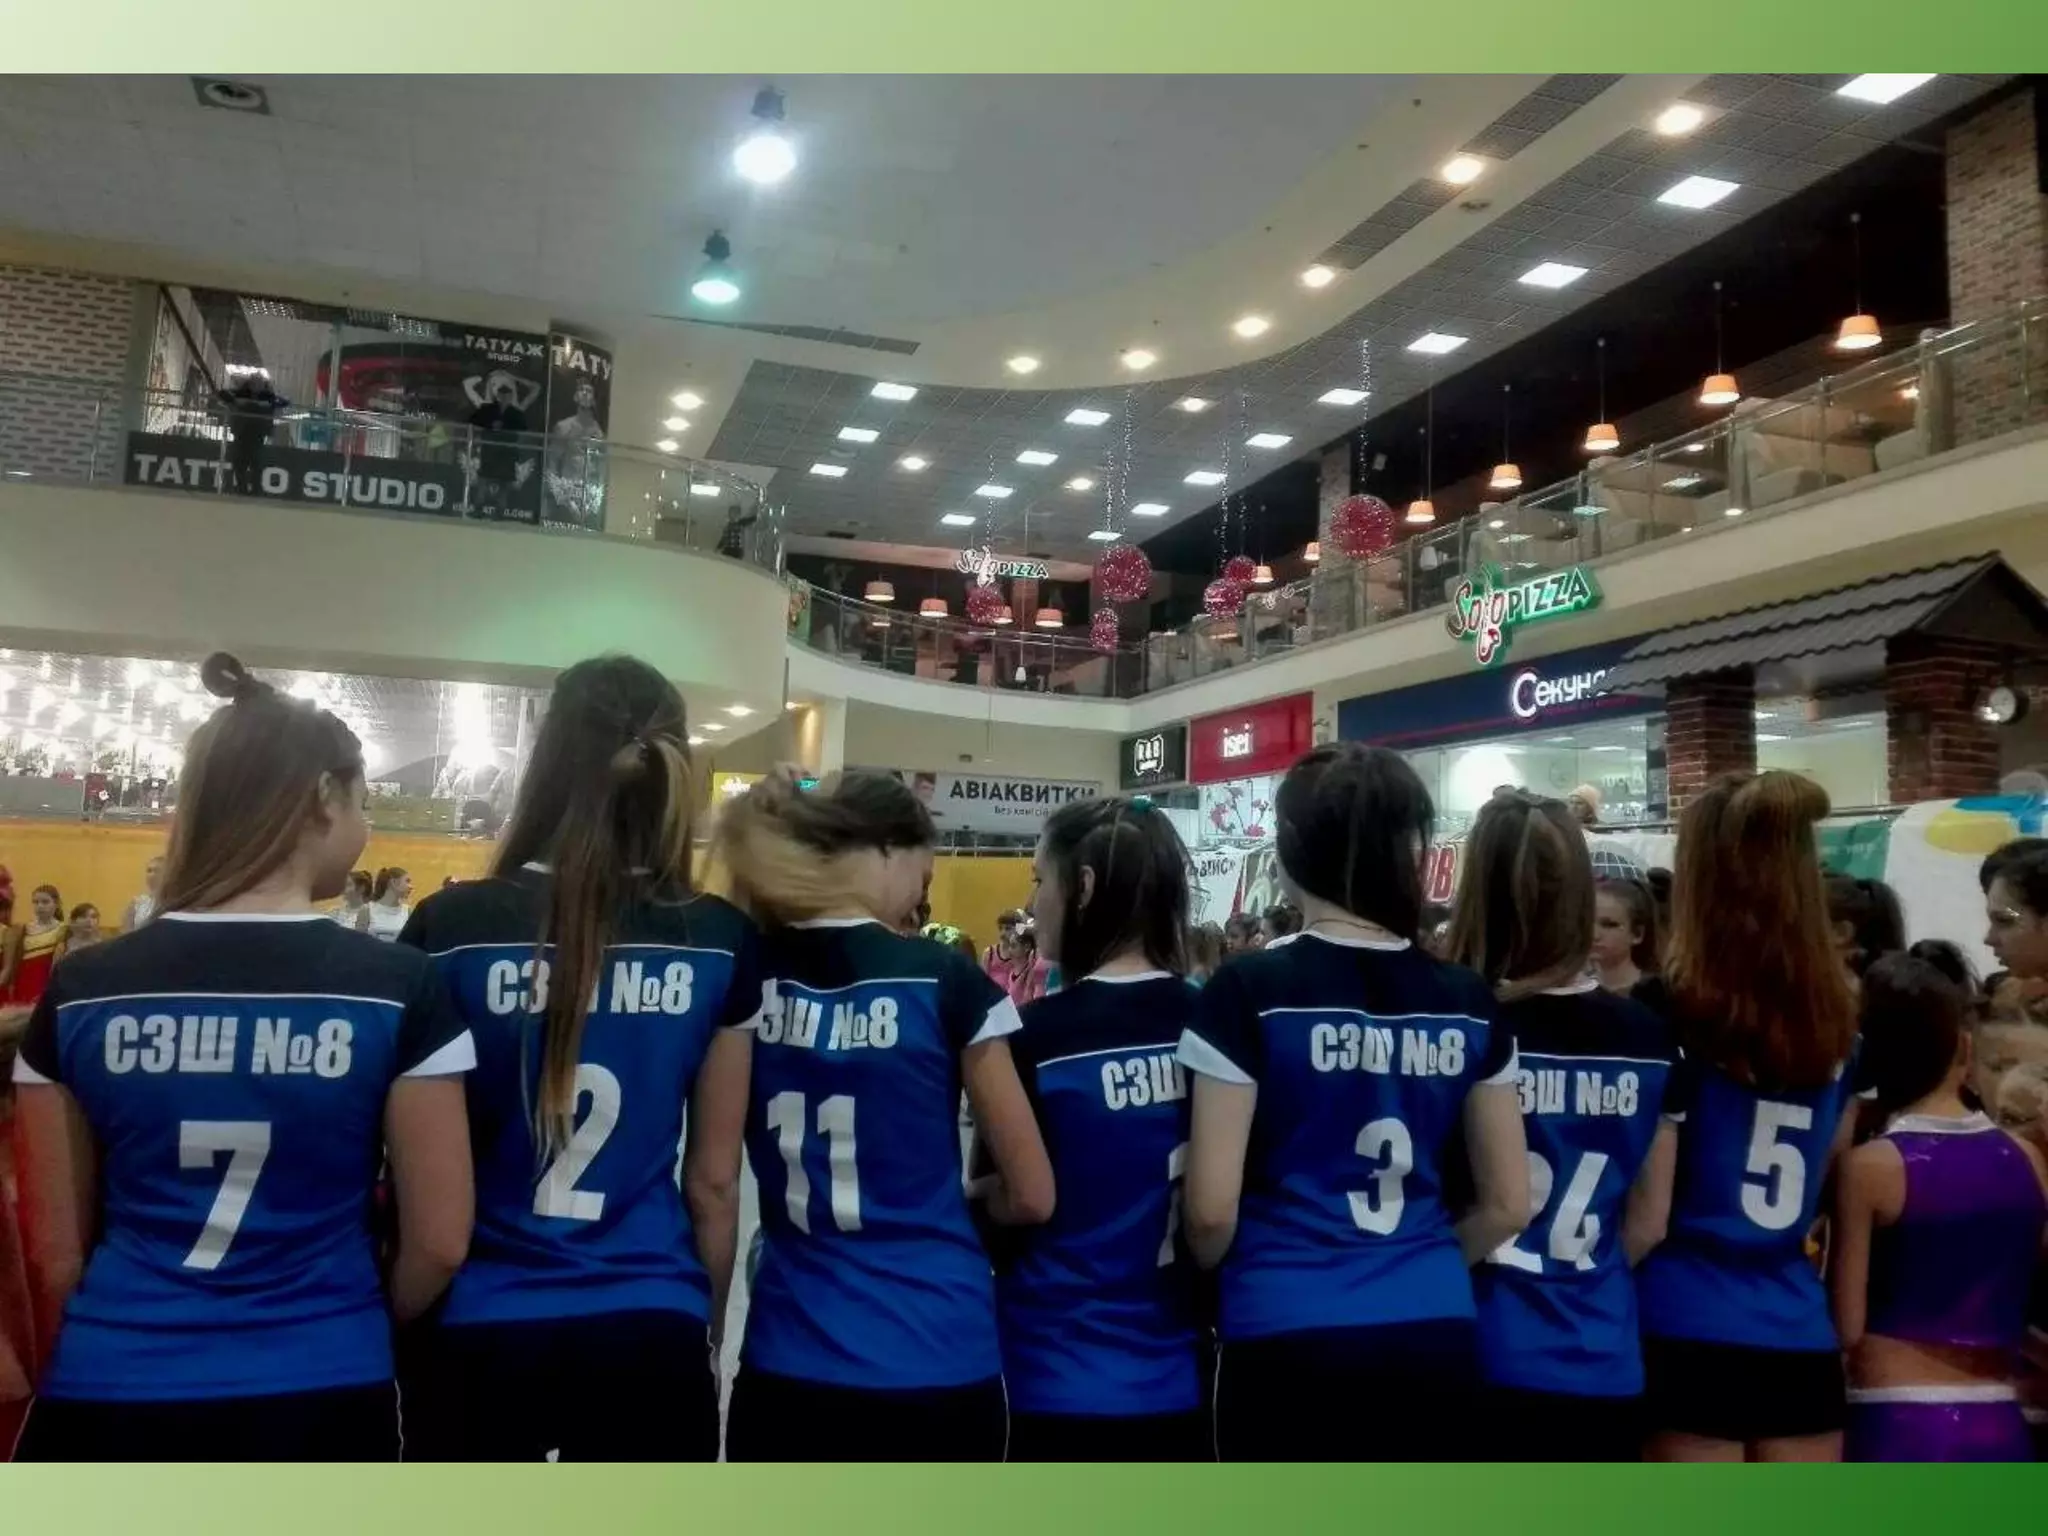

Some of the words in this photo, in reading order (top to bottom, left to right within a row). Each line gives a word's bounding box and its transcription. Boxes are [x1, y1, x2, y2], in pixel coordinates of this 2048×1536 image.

[464, 333, 545, 358] ТАТУАЖ
[133, 452, 289, 495] TATTO
[303, 471, 445, 511] STUDIO
[998, 561, 1049, 579] PIZZA
[1506, 567, 1592, 622] PIZZA
[487, 959, 598, 1015] СЗ
[611, 960, 694, 1015] №8
[104, 1014, 239, 1075] СЗШ
[251, 1017, 354, 1079] №8
[757, 990, 823, 1045] ЗШ
[827, 996, 899, 1051] №8
[1400, 1028, 1465, 1077] №8
[1516, 1068, 1567, 1115] ЗШ
[1576, 1071, 1639, 1117] №8
[533, 1063, 622, 1221] 2
[766, 1090, 863, 1235] 11
[1740, 1100, 1813, 1231] 5
[178, 1119, 272, 1270] 7
[1346, 1117, 1414, 1247] 3
